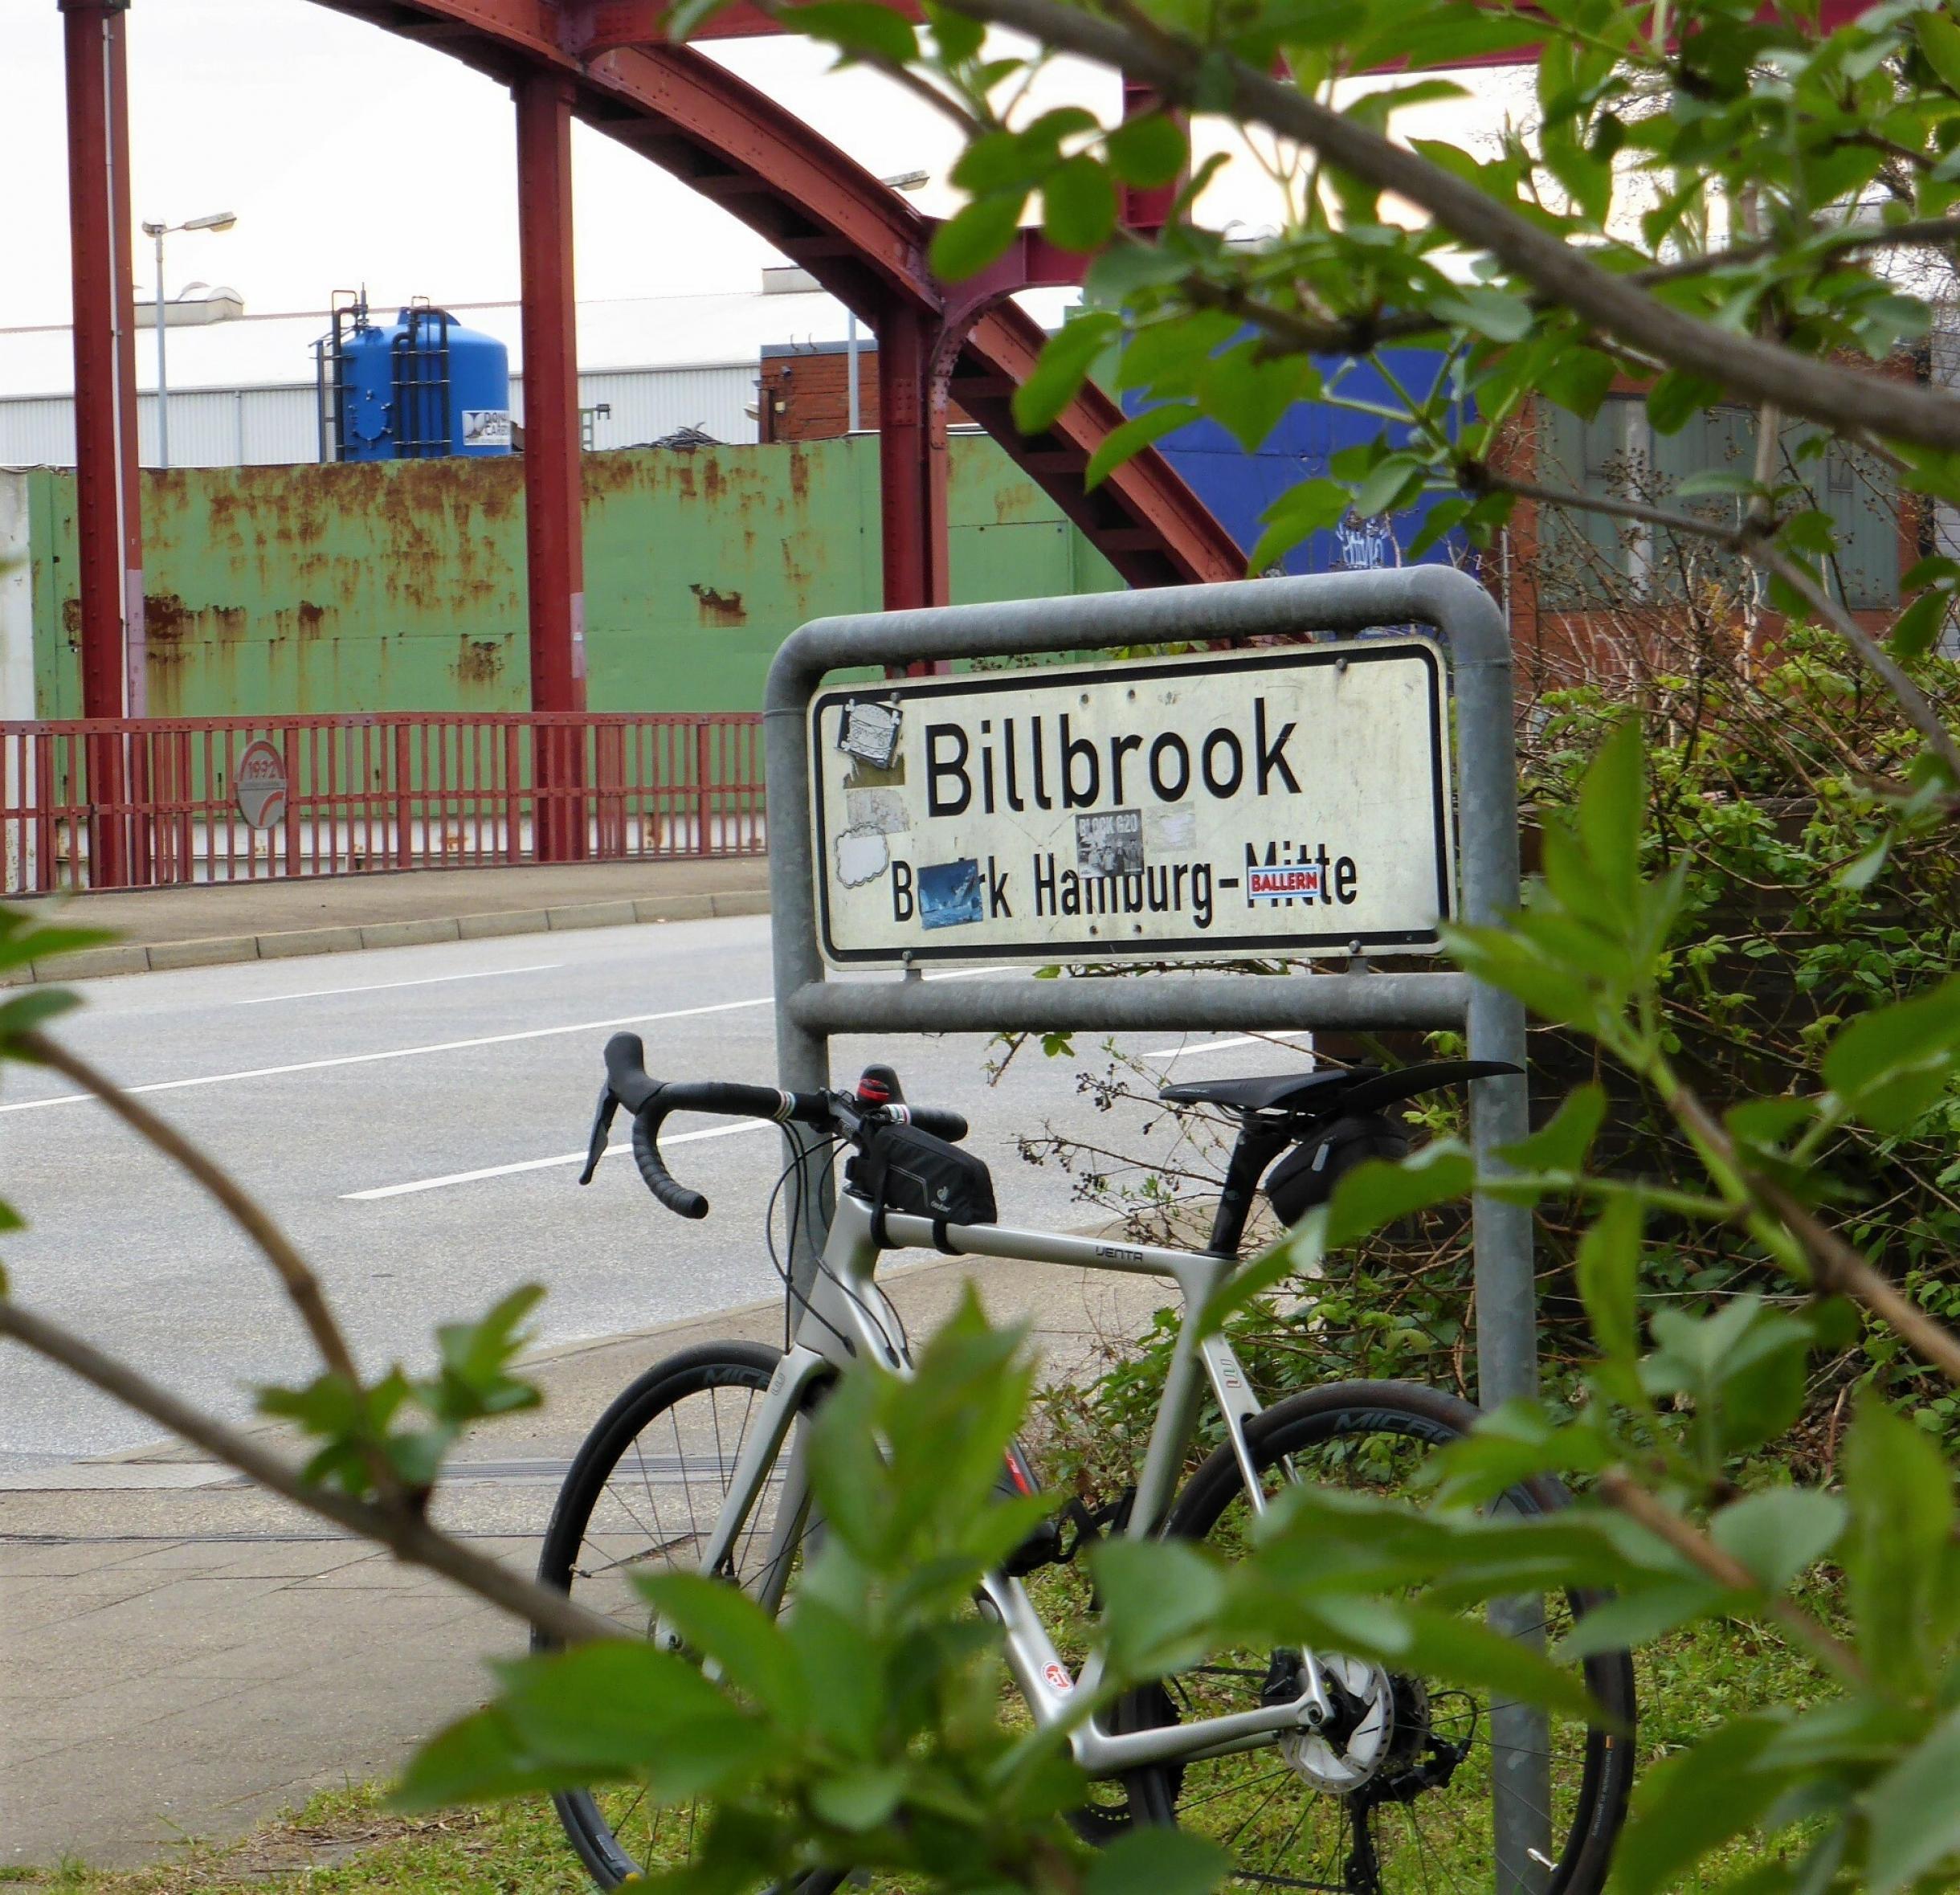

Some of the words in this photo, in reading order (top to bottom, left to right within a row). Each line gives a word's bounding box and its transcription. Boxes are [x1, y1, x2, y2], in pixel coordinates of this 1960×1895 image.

[925, 696, 1301, 818] Billbrook
[1078, 815, 1115, 837] BLOCK
[1116, 813, 1139, 834] G20
[1251, 871, 1318, 892] BALLERN
